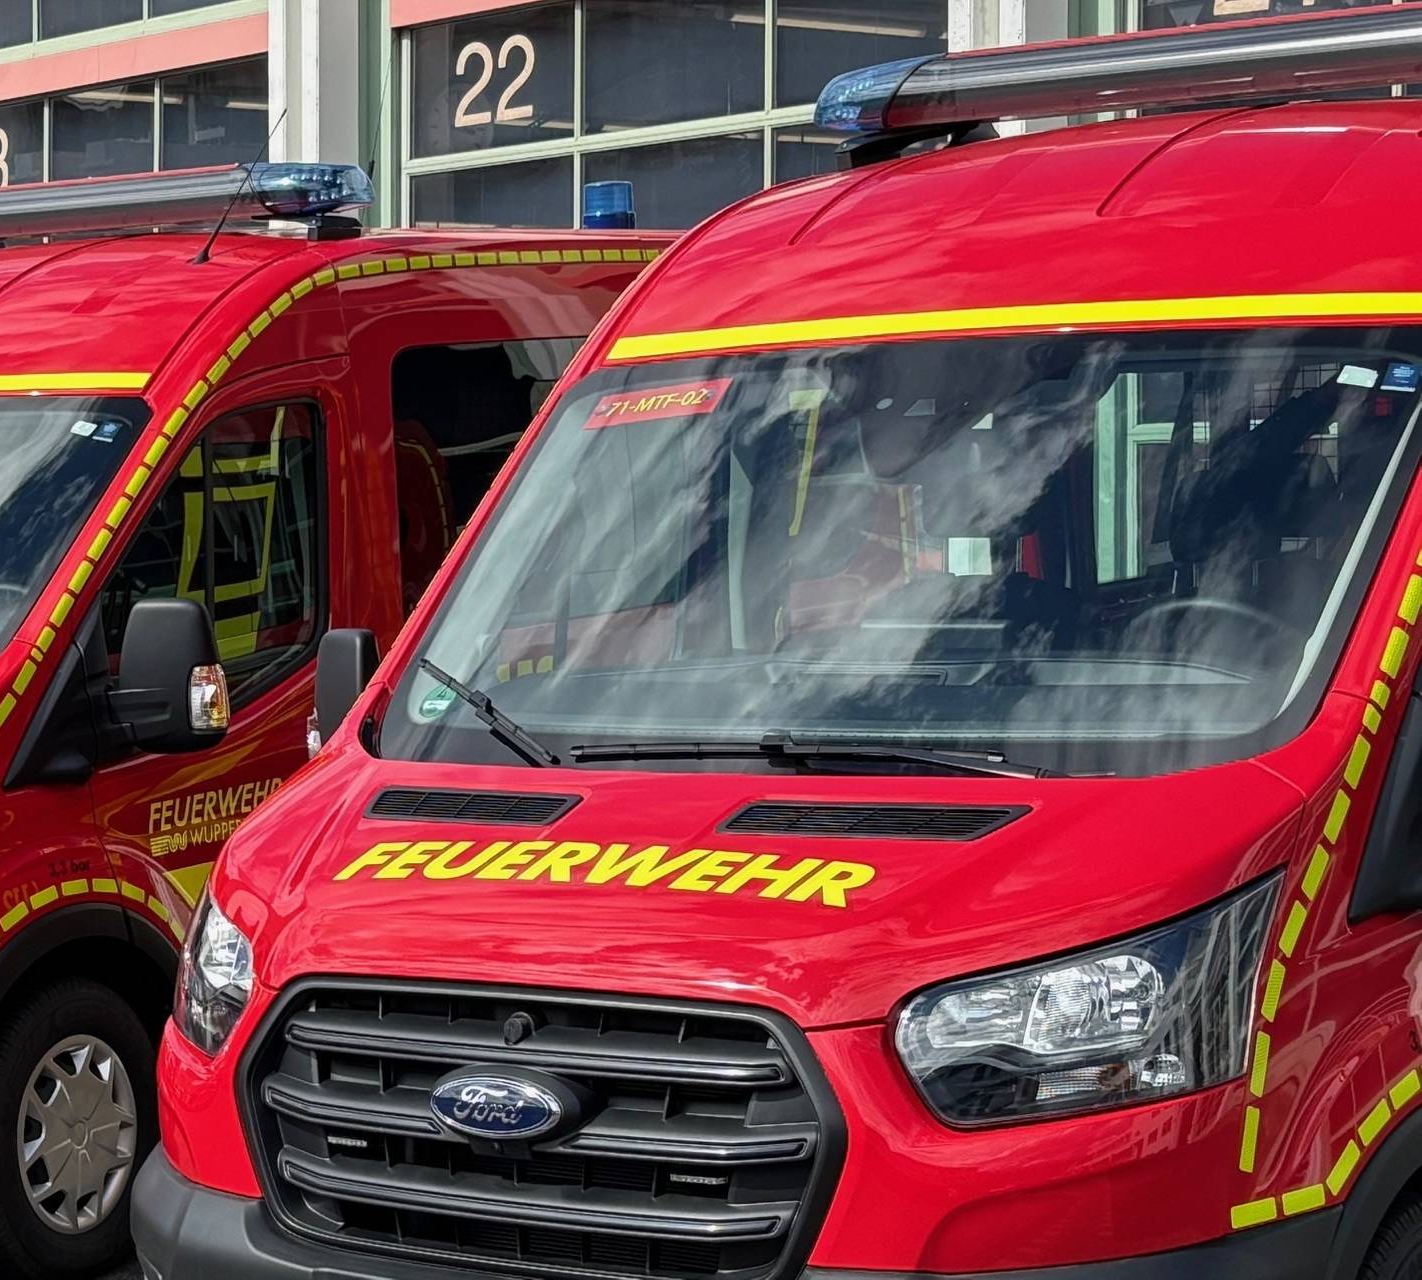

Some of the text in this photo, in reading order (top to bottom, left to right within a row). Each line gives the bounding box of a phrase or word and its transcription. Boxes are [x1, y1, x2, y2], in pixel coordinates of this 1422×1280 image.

[454, 34, 535, 128] 22
[605, 388, 709, 417] 71-MTF-02
[334, 841, 876, 908] FEUERWEHR
[453, 1085, 525, 1124] Ford
